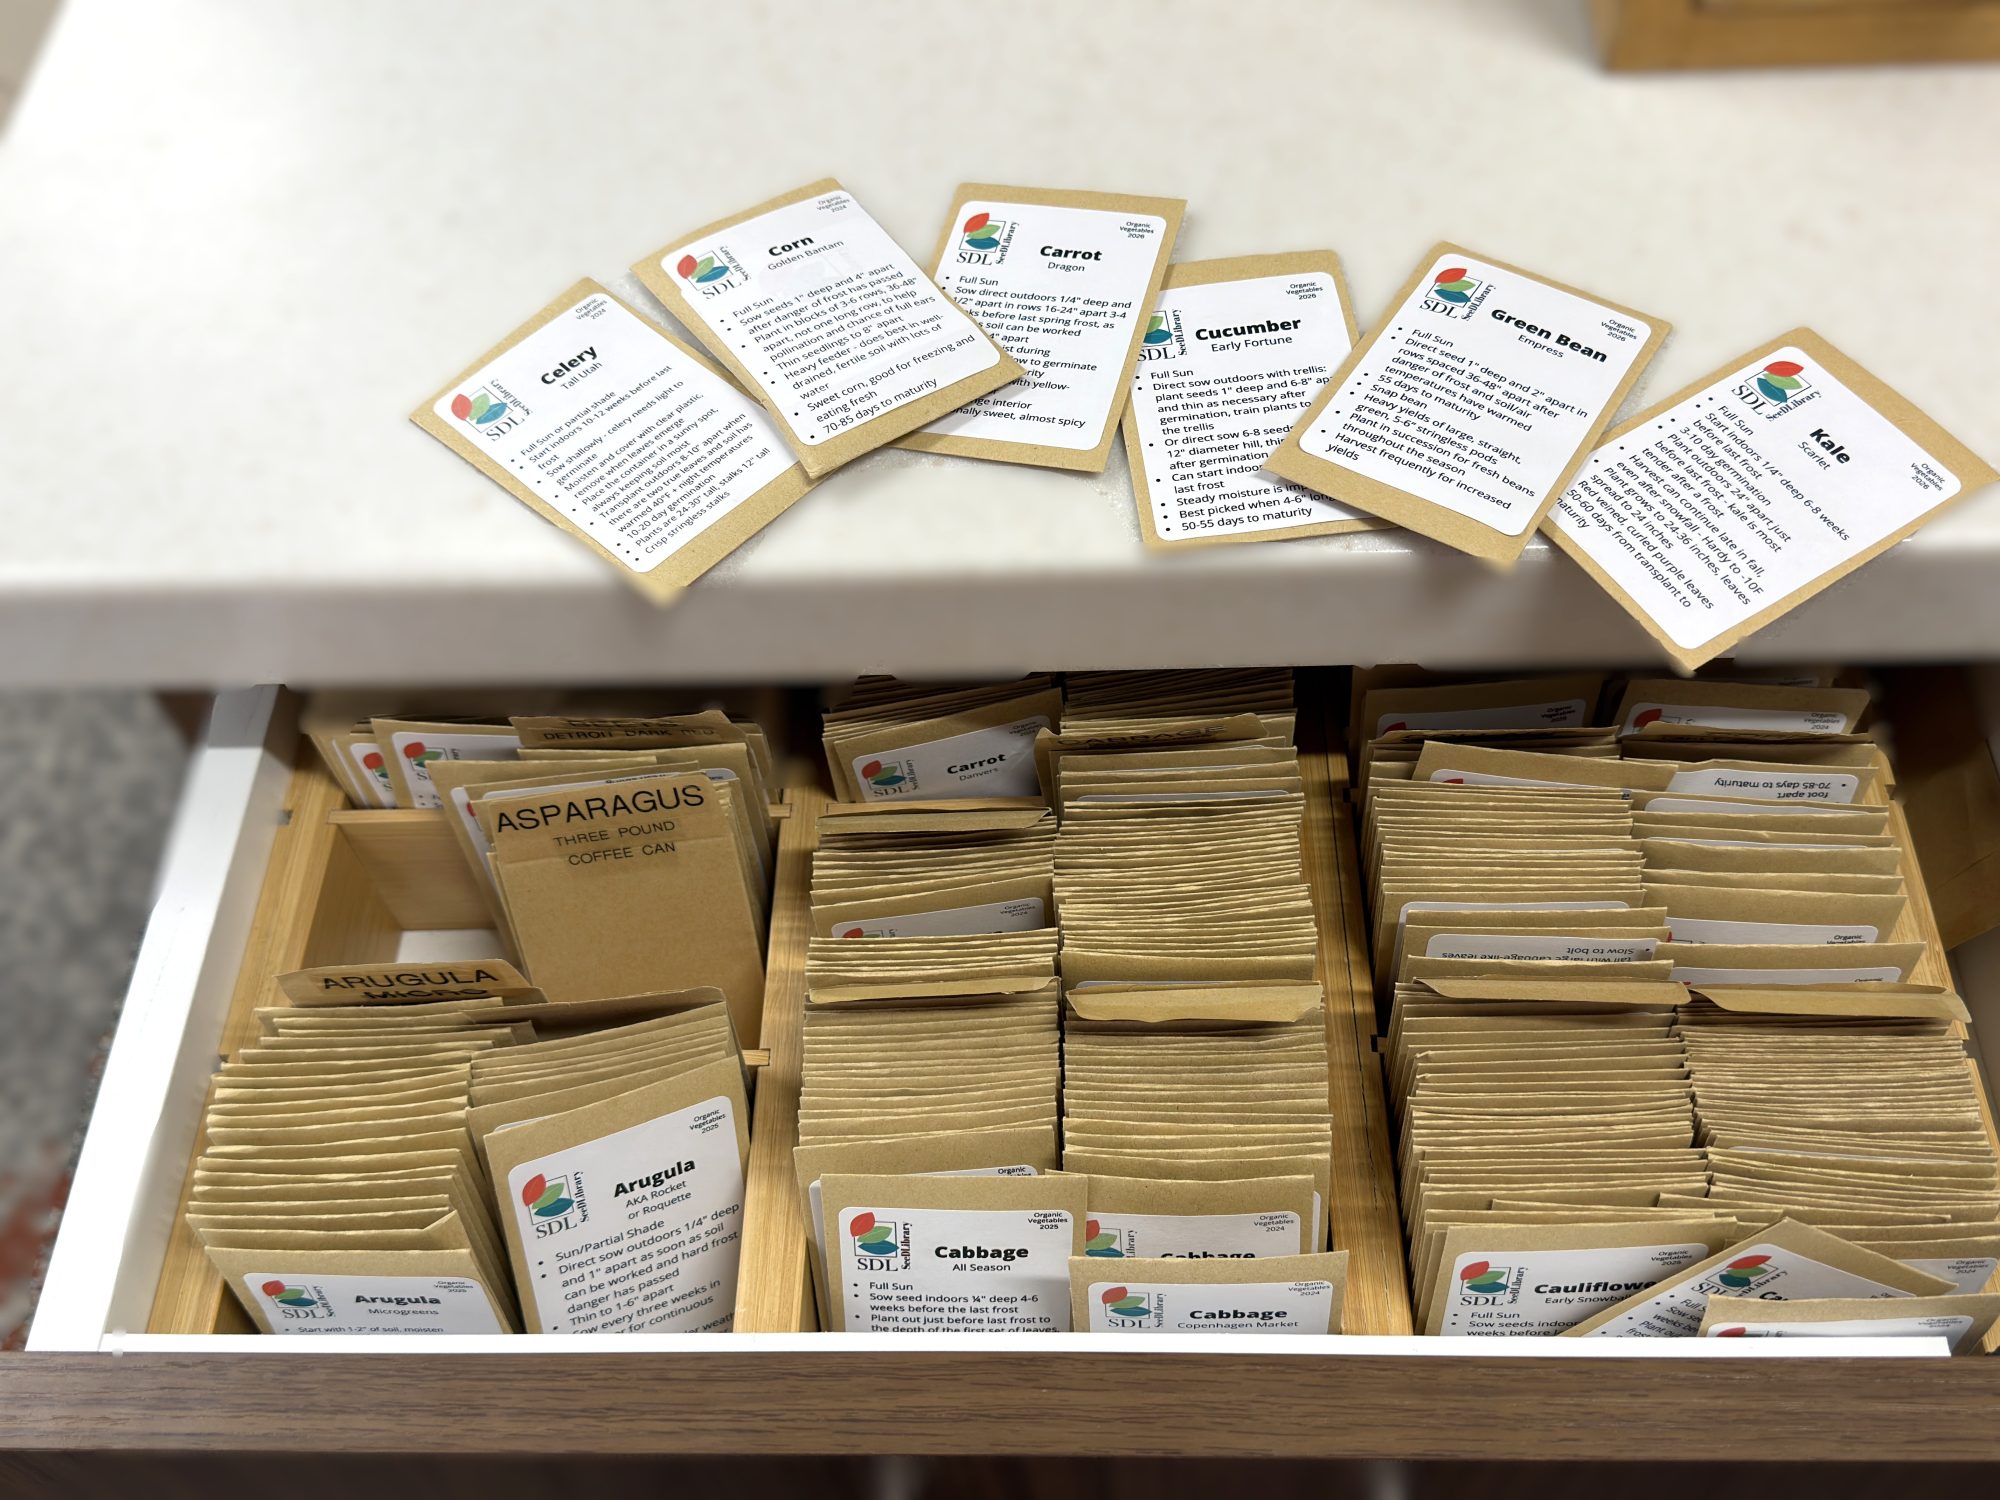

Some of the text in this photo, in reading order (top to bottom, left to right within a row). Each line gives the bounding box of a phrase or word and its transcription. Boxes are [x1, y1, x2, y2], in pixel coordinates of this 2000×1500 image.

[1118, 225, 1154, 234] Vegetables
[1124, 220, 1151, 228] Organic
[1126, 231, 1145, 239] 2026
[767, 236, 814, 256] Corn
[767, 240, 844, 270] Golden Bantam
[1039, 244, 1102, 261] Carrot
[955, 250, 992, 266] SDL
[1047, 260, 1085, 272] Dragon
[698, 278, 742, 300] SDL
[958, 274, 999, 286] Full Sun
[1284, 285, 1323, 295] Vegetables
[1288, 280, 1317, 289] Organic
[1296, 292, 1317, 300] 2026
[731, 296, 774, 318] Full Sun
[1418, 296, 1458, 319] SDL
[1194, 318, 1301, 341] Cucumber
[1490, 308, 1607, 363] Green Bean
[1600, 320, 1637, 340] Vegetables
[1605, 318, 1636, 333] Organic
[1210, 335, 1292, 352] Early Fortune
[1410, 328, 1454, 348] Full Sun
[1517, 333, 1564, 358] Empress
[1606, 330, 1626, 342] 2026
[1136, 346, 1176, 362] SDL
[540, 345, 597, 385] Celery
[559, 361, 603, 389] Tall Utah
[806, 333, 975, 411] Sweet corn, good for freezing and
[1149, 369, 1194, 380] Full Sun
[1369, 383, 1428, 409] Snap bean
[1730, 383, 1767, 415] SDL
[485, 415, 525, 442] SDL
[519, 391, 616, 456] Full Sun or partial shade
[1717, 404, 1754, 436] Full Sun
[1797, 440, 1831, 470] Scarlet
[1808, 427, 1850, 464] Kale
[1678, 425, 1771, 506] 3-10 day germination
[1920, 462, 1945, 484] Organic
[1910, 461, 1943, 491] Vegetables
[1910, 474, 1930, 490] 2026
[1181, 507, 1312, 531] 50-55 days to maturity
[948, 753, 1006, 774] Carrot
[959, 768, 999, 781] Danvers
[874, 786, 909, 797] SDL
[498, 784, 704, 832] ASPARAGUS
[553, 821, 675, 847] THREE POUND
[569, 843, 676, 866] COFFEE CAN
[324, 970, 498, 990] ARUGULA
[689, 1113, 726, 1131] Vegetables
[694, 1109, 720, 1122] Organic
[702, 1123, 719, 1134] 2025
[614, 1159, 696, 1198] Arugula
[998, 1166, 1026, 1174] Organic
[626, 1180, 687, 1208] AKA Rocket
[628, 1192, 692, 1219] or Roquette
[536, 1217, 578, 1239] SDL
[1254, 1219, 1294, 1227] Vegetables
[555, 1219, 665, 1262] Sun/Partial Shade
[935, 1245, 1029, 1261] Cabbage
[857, 1258, 898, 1271] SDL
[952, 1263, 967, 1271] All
[869, 1282, 913, 1290] Full Sun
[1534, 1280, 1657, 1295] Cauliflowe
[1460, 1296, 1503, 1306] SDL
[1545, 1296, 1575, 1304] Early
[1108, 1319, 1150, 1328] SDL
[1189, 1310, 1287, 1320] Cabbage
